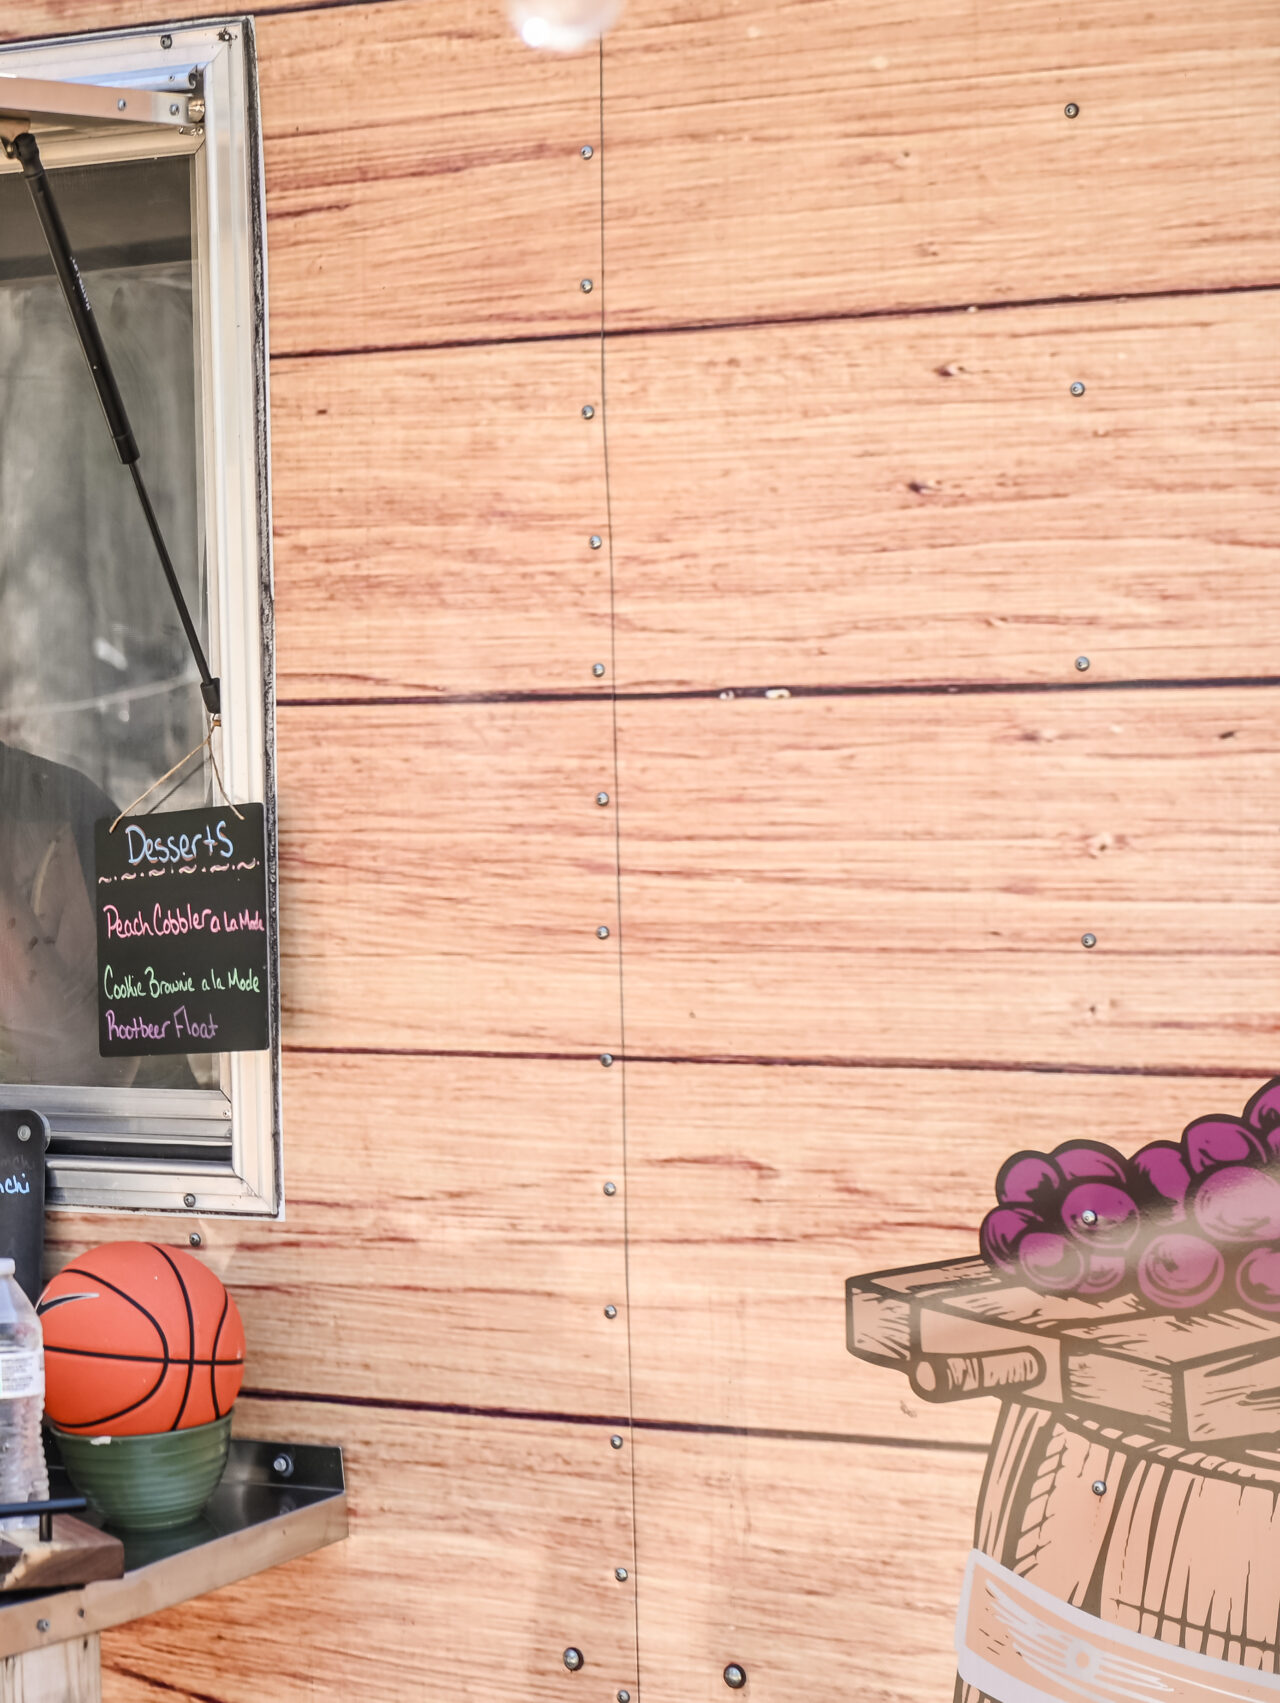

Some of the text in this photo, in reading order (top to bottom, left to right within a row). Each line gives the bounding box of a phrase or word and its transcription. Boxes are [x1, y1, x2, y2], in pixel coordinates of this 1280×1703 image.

[103, 904, 154, 939] Peach
[153, 902, 212, 936] Cobbler
[210, 915, 221, 933] a
[239, 908, 265, 932] Mode
[104, 964, 261, 1000] Cookie Brownie a la Mode
[105, 1005, 219, 1041] Rootbeer Float
